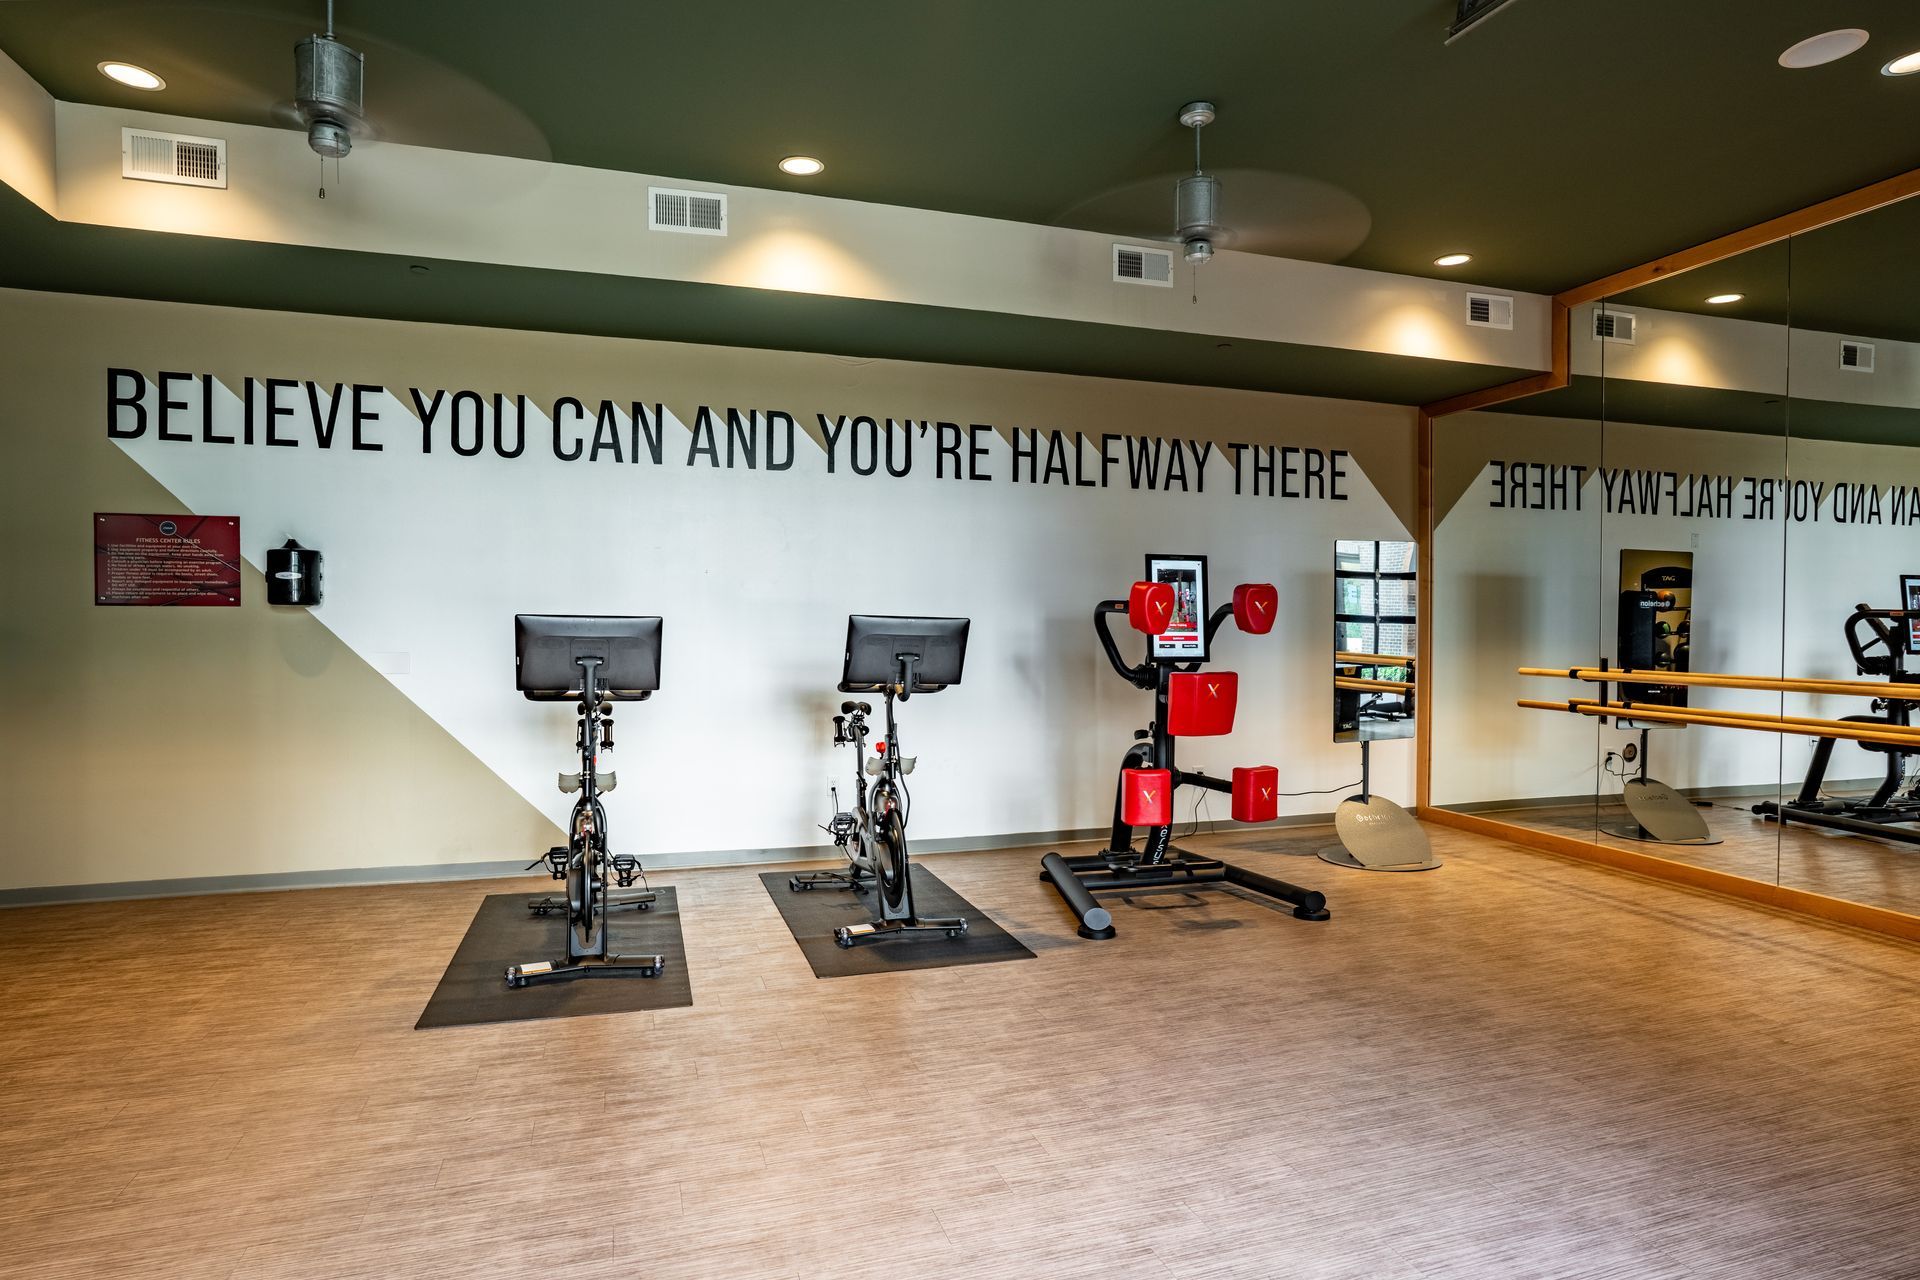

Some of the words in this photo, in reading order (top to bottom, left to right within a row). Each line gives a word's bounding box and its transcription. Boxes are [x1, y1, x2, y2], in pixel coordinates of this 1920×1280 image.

[107, 368, 384, 452] BELIEVE
[409, 388, 525, 459] YOU
[553, 397, 663, 465] CAN
[687, 406, 794, 471] AND
[817, 414, 993, 481] YOU'RE
[1013, 427, 1213, 493] HALFWAY
[1228, 443, 1349, 501] THERE
